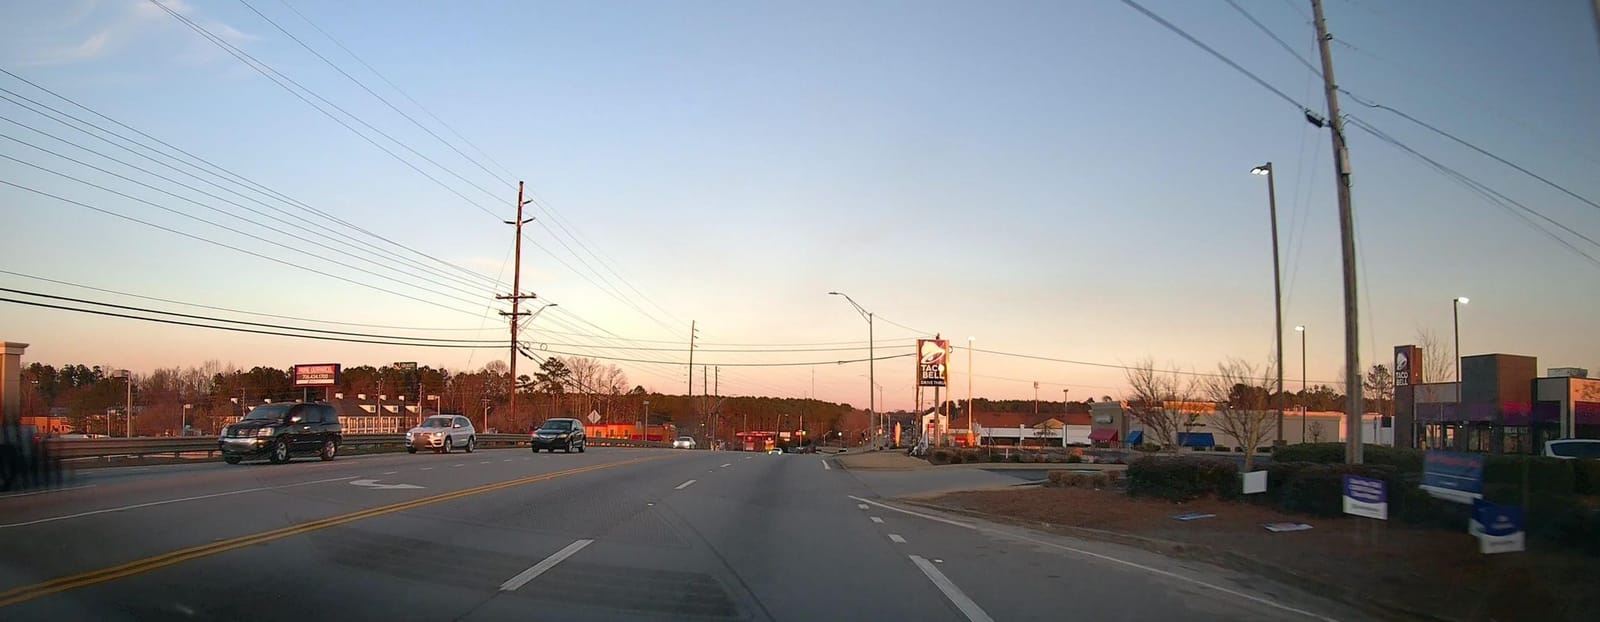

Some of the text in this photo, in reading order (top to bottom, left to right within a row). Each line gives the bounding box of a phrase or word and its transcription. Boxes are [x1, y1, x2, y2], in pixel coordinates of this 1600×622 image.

[920, 364, 945, 372] TAC
[922, 371, 945, 379] BELL
[1395, 371, 1409, 379] TACO
[1396, 378, 1409, 386] BELL
